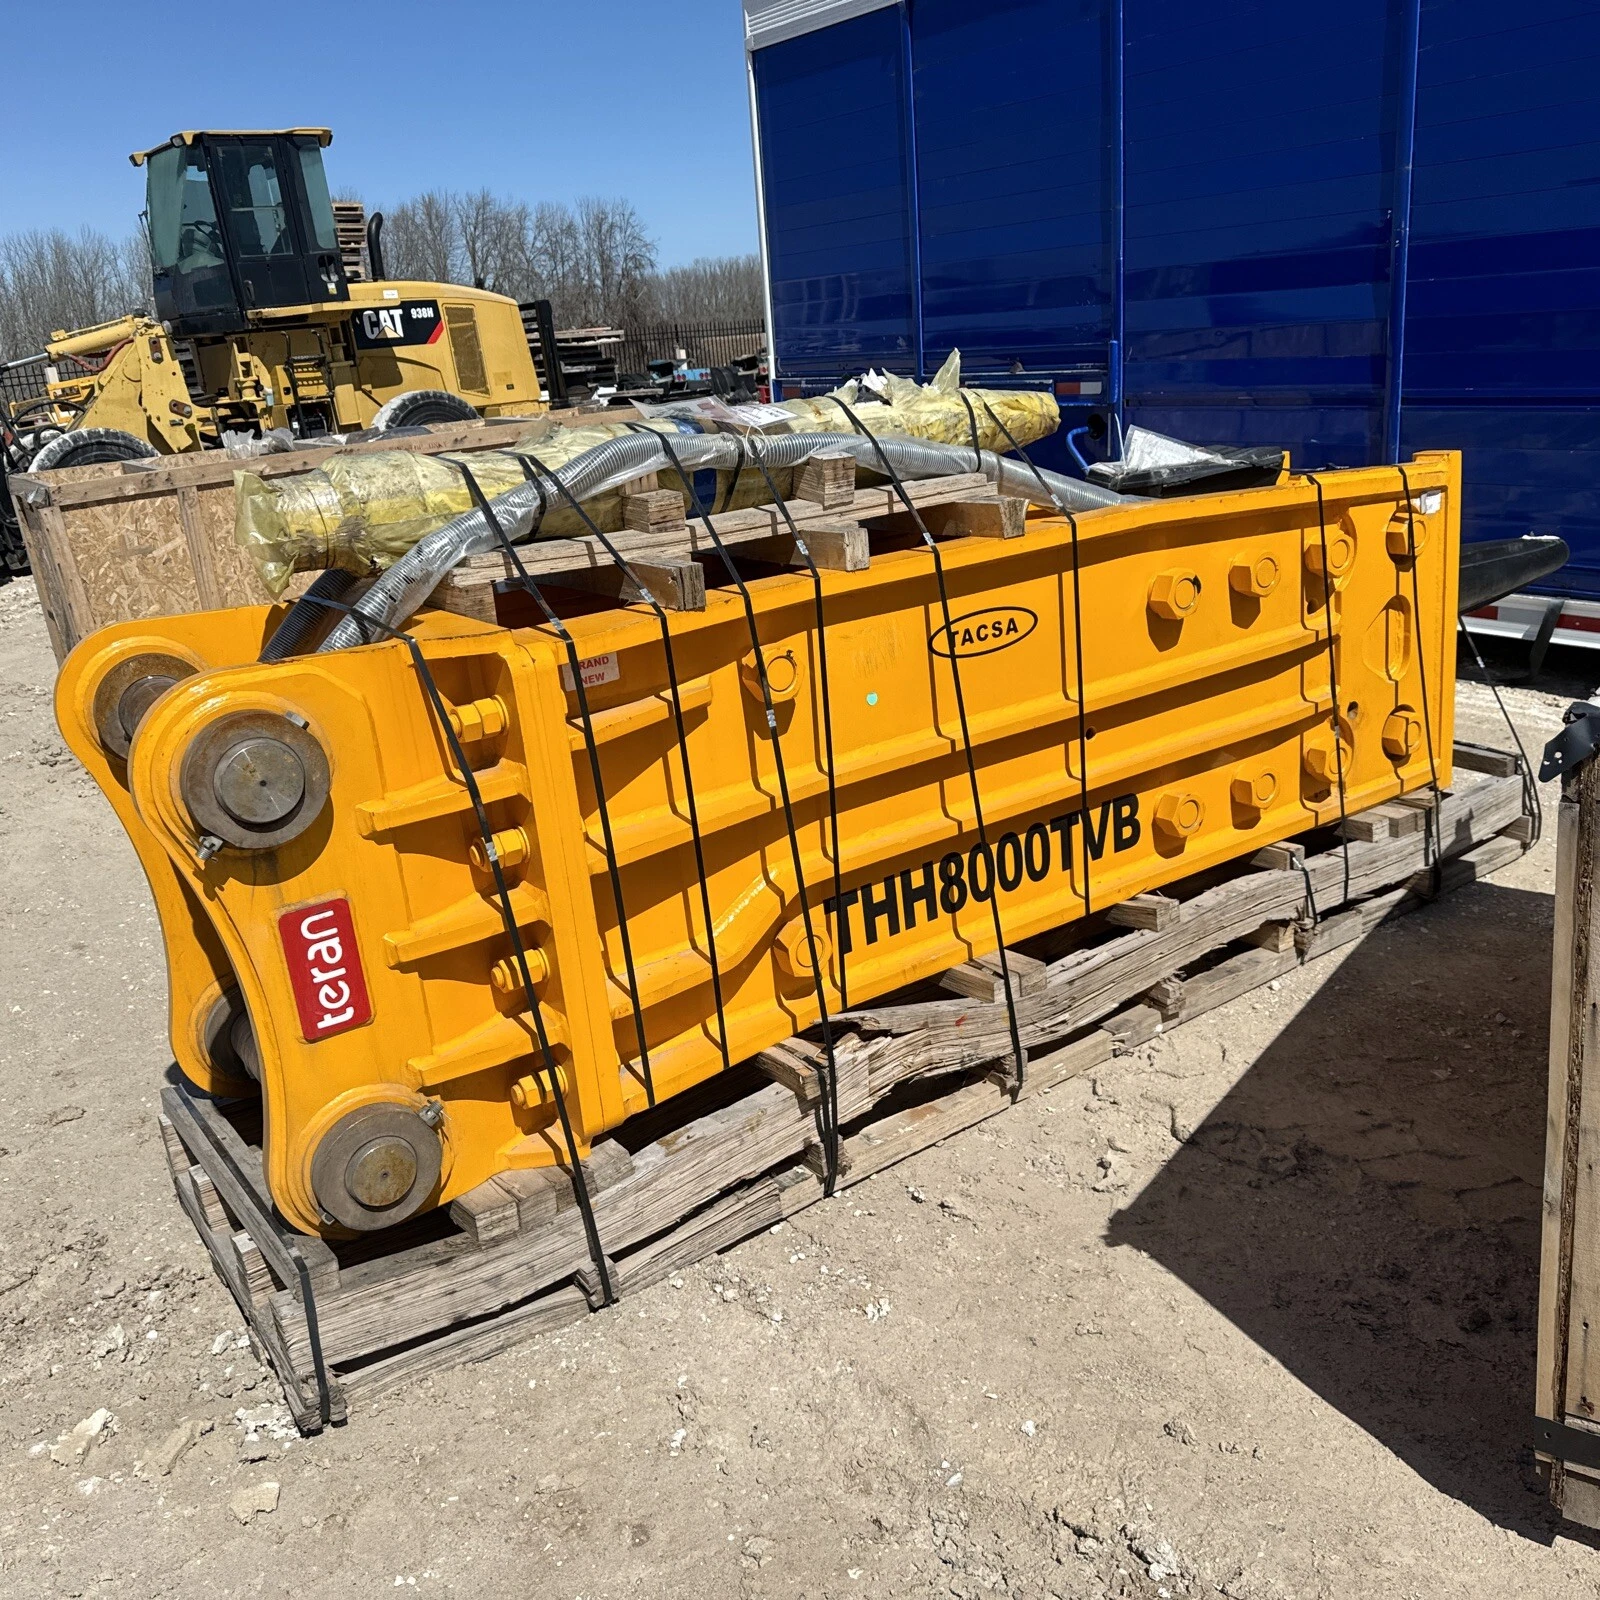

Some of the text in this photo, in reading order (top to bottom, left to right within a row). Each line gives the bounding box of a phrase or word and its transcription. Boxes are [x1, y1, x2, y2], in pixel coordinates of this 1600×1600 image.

[363, 309, 404, 339] CAT
[410, 307, 434, 319] 938H
[574, 656, 610, 672] RAND
[581, 672, 605, 685] NEW
[823, 793, 1141, 955] THH8000TVB
[300, 910, 354, 1029] teran
